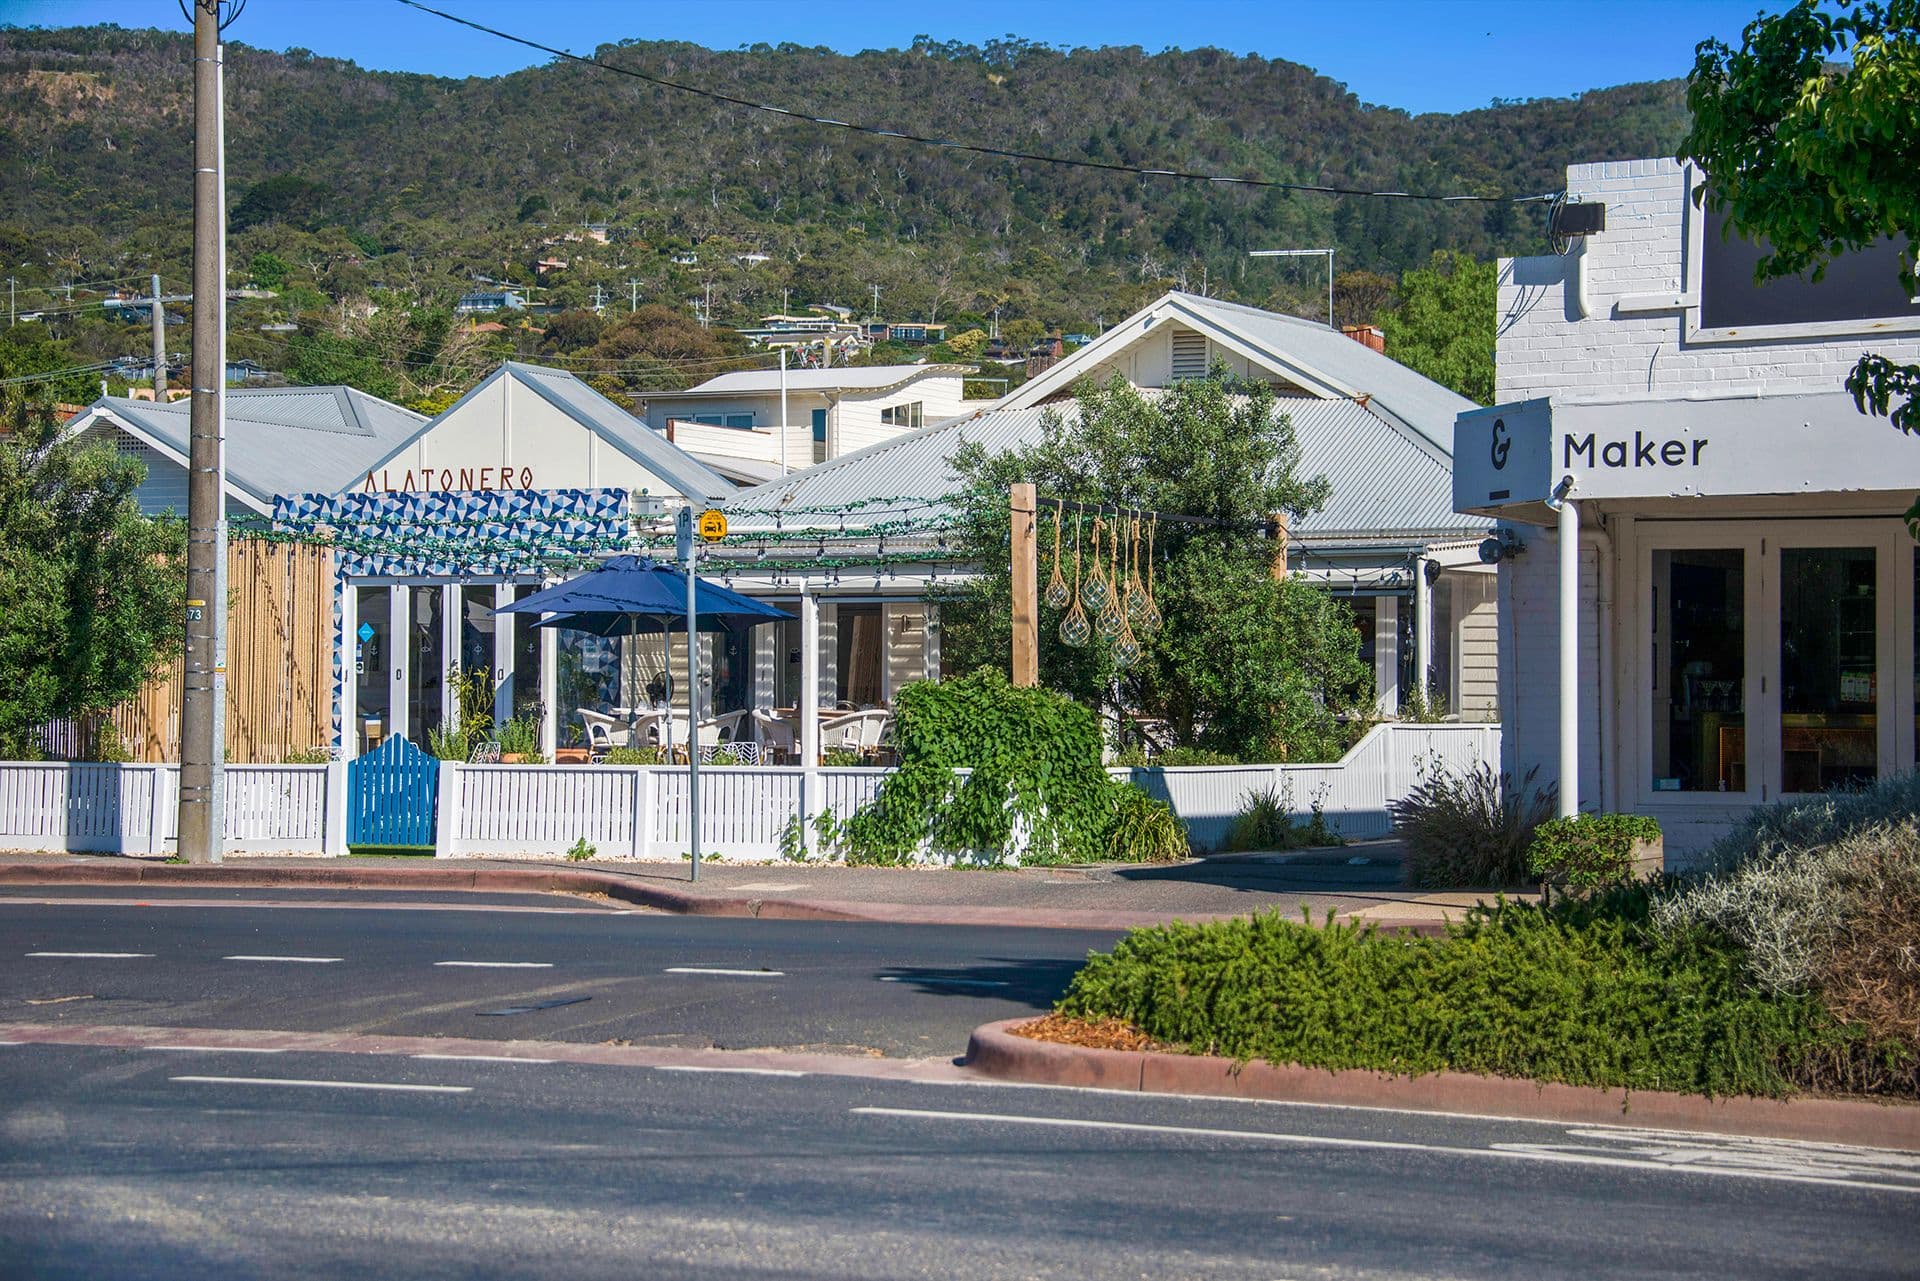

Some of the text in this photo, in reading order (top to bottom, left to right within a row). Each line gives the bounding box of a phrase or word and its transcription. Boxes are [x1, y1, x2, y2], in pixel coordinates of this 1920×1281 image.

[1490, 418, 1511, 471] &
[1563, 431, 1708, 468] Maker
[364, 467, 533, 493] ALATONERO
[678, 513, 689, 528] 1P
